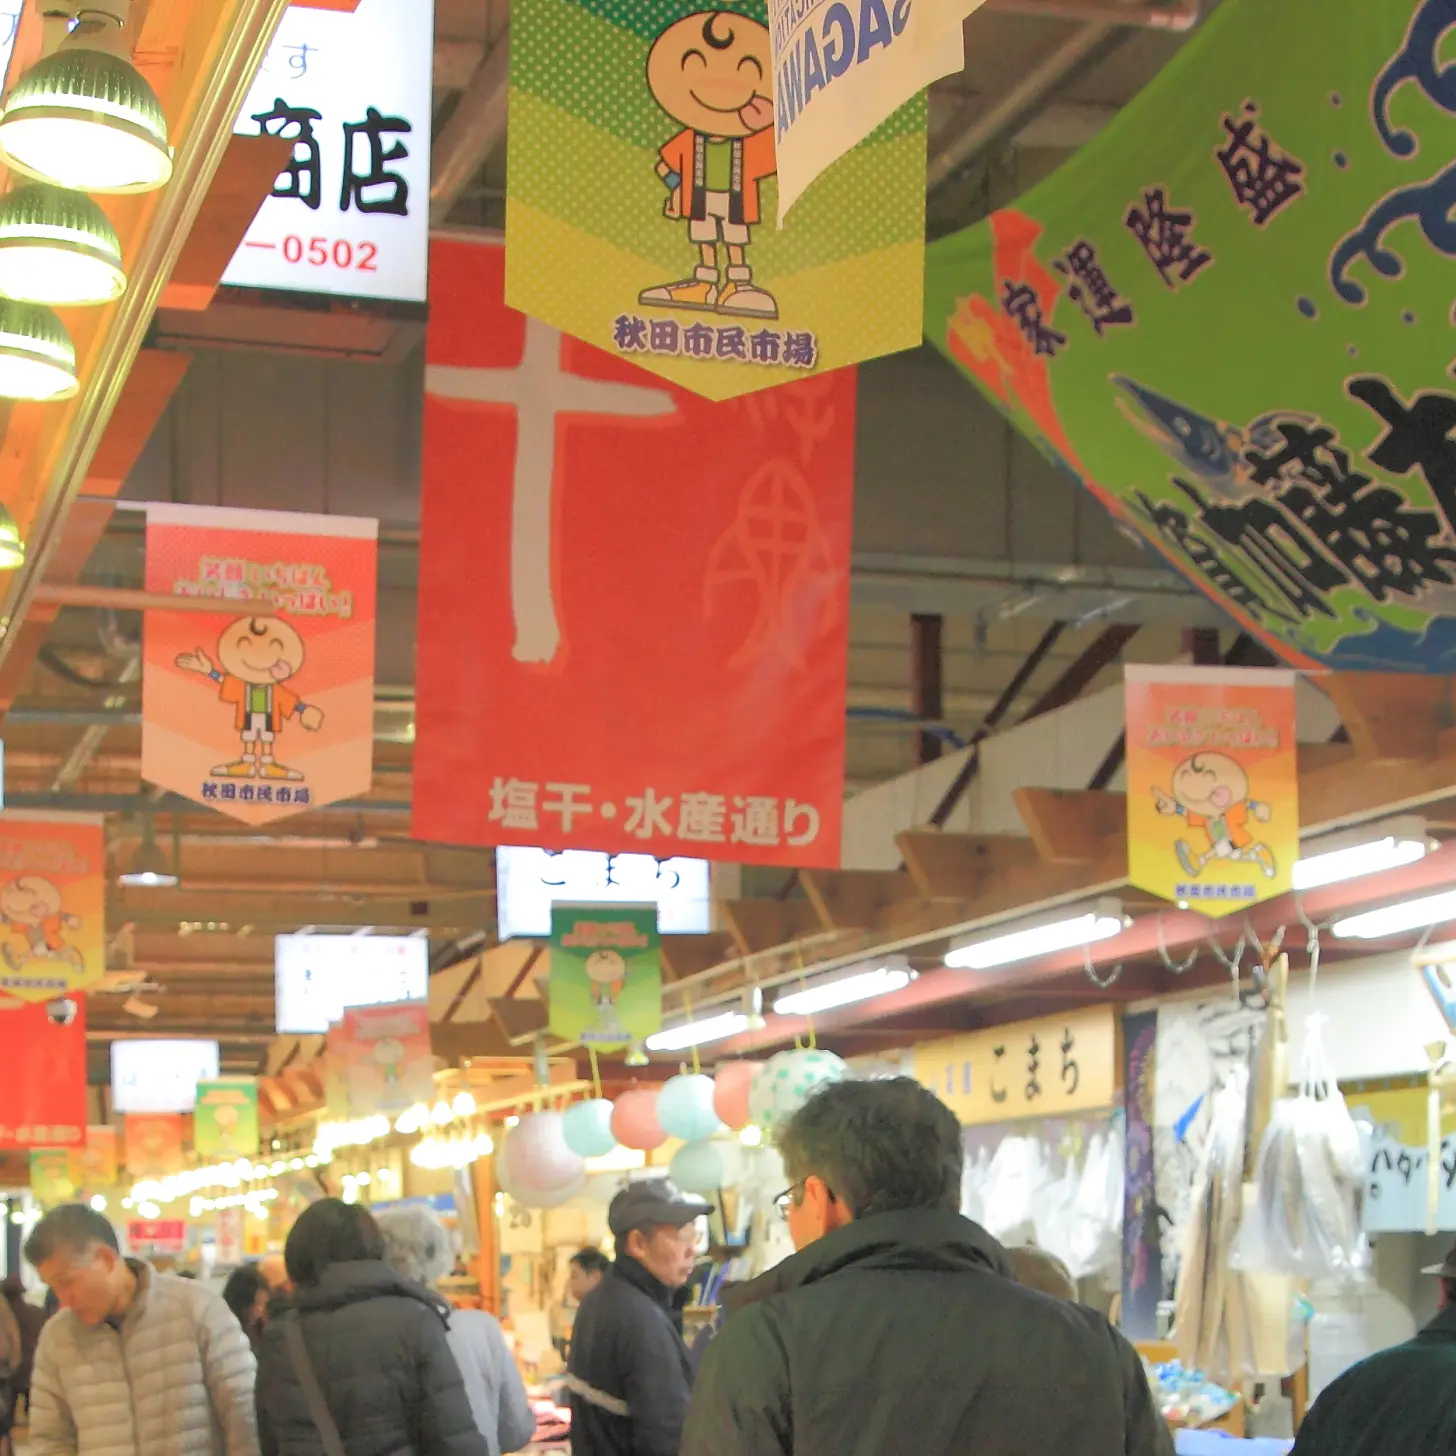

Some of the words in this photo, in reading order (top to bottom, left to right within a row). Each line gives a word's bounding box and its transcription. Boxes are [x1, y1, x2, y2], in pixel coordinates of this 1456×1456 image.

[250, 97, 413, 216] 商店
[614, 315, 816, 366] 秋田市民市場
[202, 782, 310, 804] 秋田市民市場
[488, 777, 822, 848] 塩干・水産通り
[990, 1027, 1080, 1103] こまち
